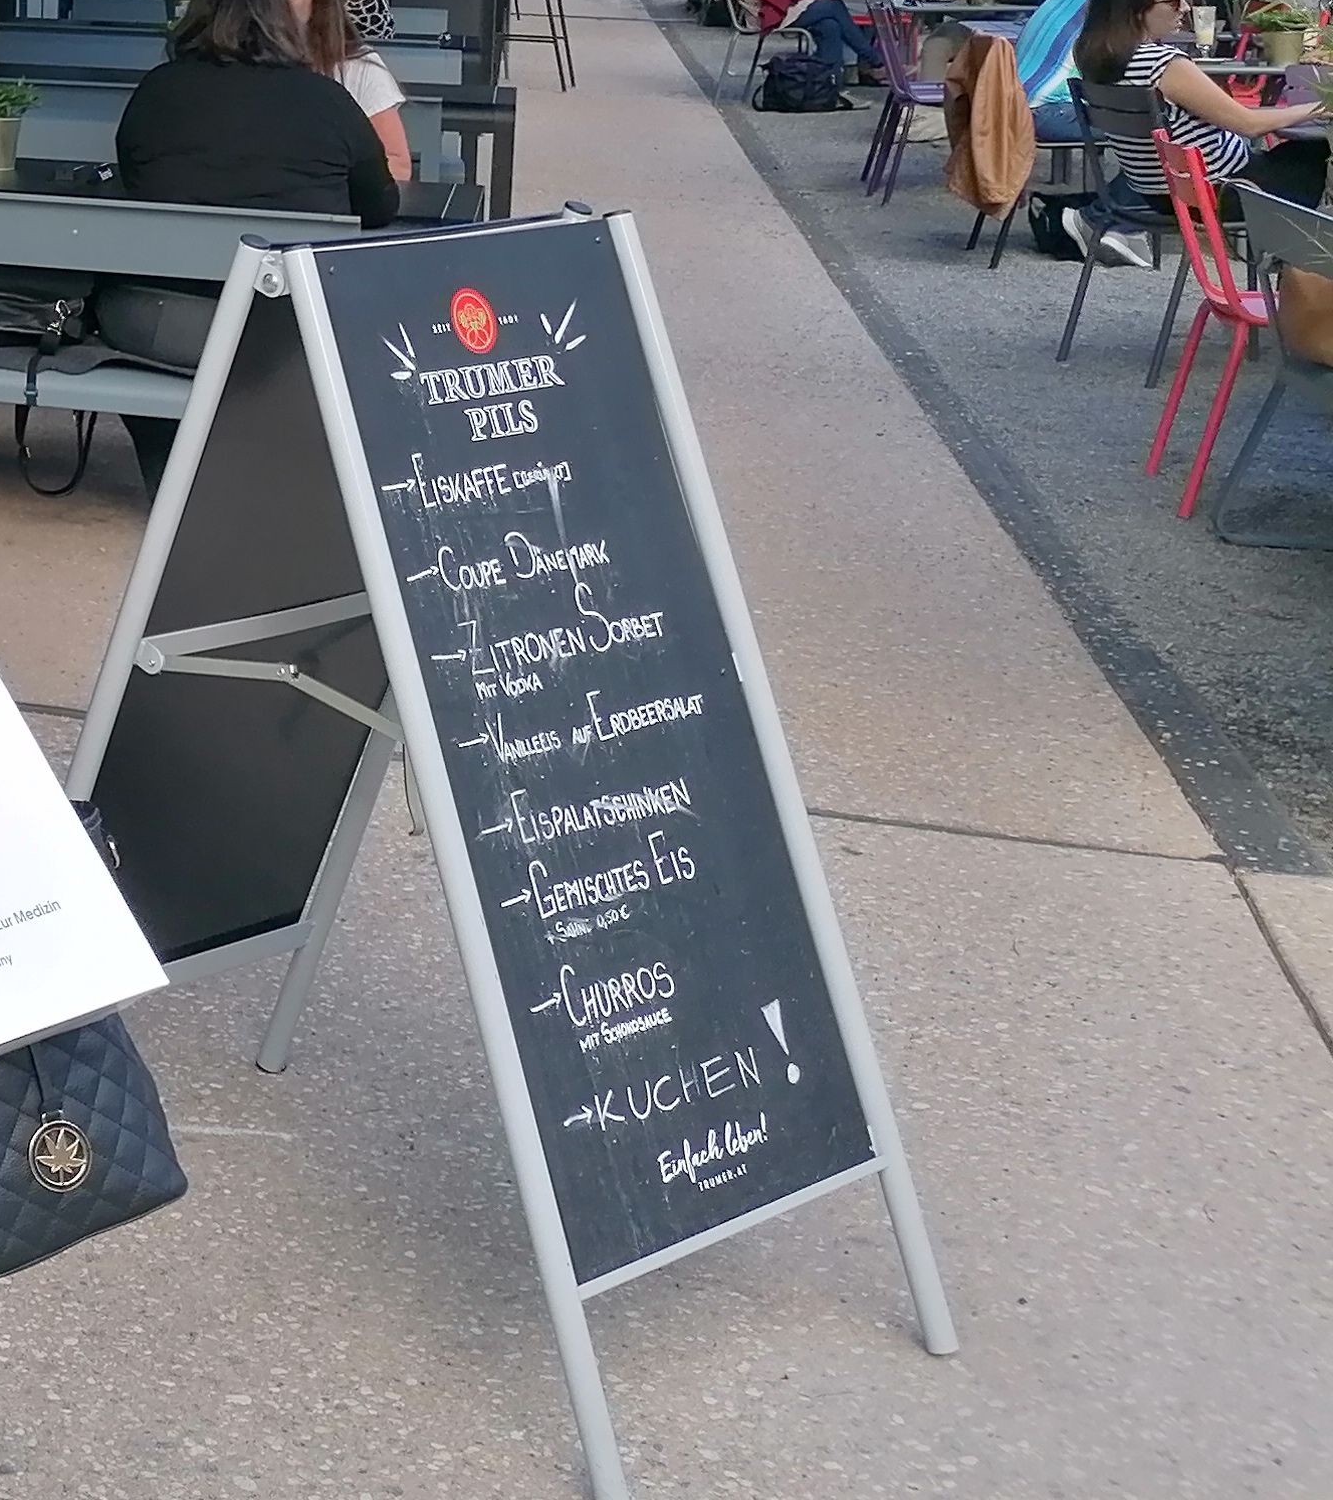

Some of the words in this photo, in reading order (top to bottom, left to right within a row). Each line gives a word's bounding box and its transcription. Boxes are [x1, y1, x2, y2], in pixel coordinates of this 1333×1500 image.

[419, 354, 566, 405] TRUMER
[463, 399, 539, 442] PILS
[437, 545, 507, 591] COUPE
[456, 619, 587, 676] ZITRONEN
[574, 582, 664, 652] SORBET
[474, 681, 497, 701] MIT
[498, 672, 544, 698] VODKA
[571, 724, 594, 745] AUF
[586, 690, 704, 742] ERDBEERSALAT
[528, 860, 651, 919] GEMISCHTES
[647, 830, 696, 885] EIS
[13, 899, 63, 926] Medizin
[559, 961, 676, 1026] CHURROS
[579, 1032, 601, 1053] MIT
[593, 1046, 761, 1131] KUCHEN
[657, 1128, 724, 1184] Einfach
[723, 1111, 769, 1157] leben!
